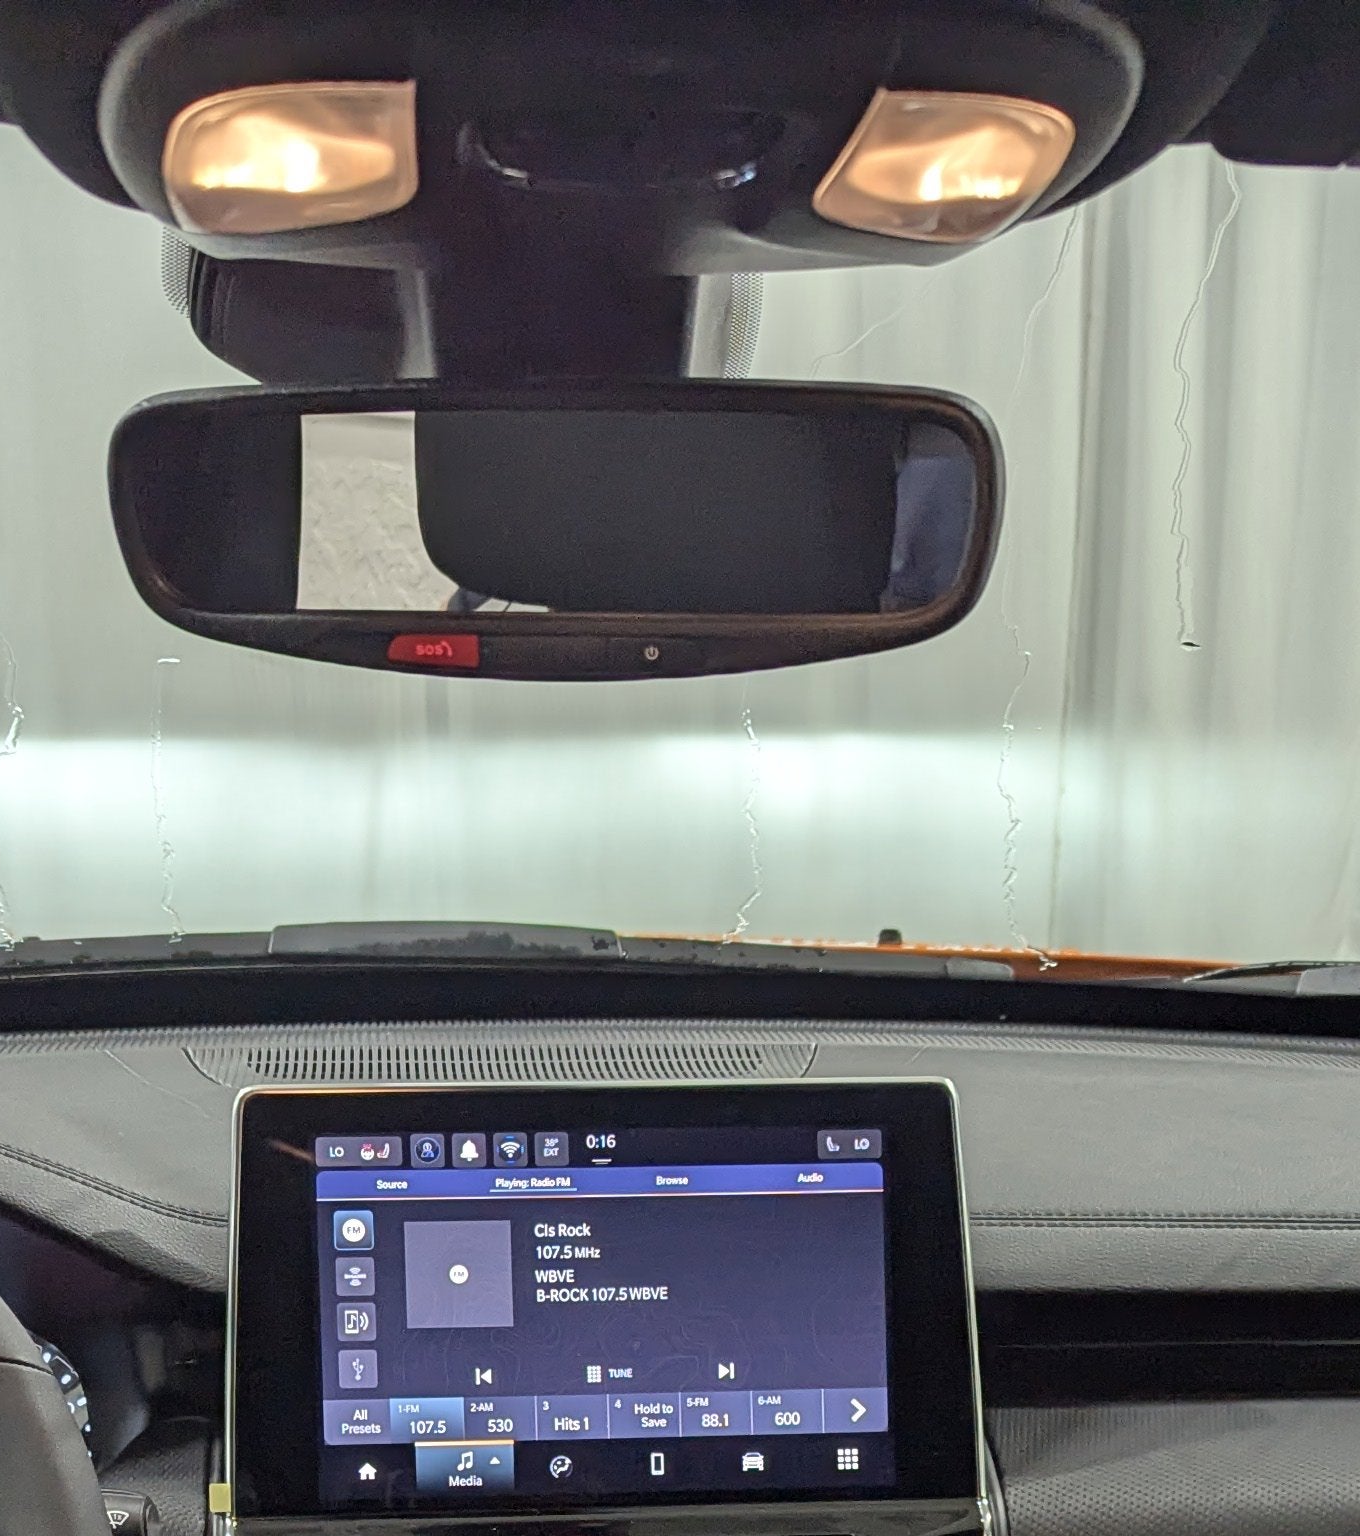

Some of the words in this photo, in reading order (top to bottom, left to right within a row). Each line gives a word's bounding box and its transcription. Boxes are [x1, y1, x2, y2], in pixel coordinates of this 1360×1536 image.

[415, 644, 444, 656] SOS
[585, 1133, 617, 1149] 0:16
[853, 1138, 870, 1151] LO
[329, 1146, 345, 1158] LO
[495, 1177, 529, 1190] Playing:
[530, 1176, 554, 1188] Radio
[555, 1176, 571, 1188] FM
[655, 1175, 689, 1186] Browse
[797, 1172, 824, 1183] Audio
[376, 1179, 408, 1190] Source
[346, 1226, 361, 1235] FM
[557, 1223, 592, 1238] Rock
[535, 1245, 573, 1260] 107.5
[574, 1247, 601, 1260] MHz
[534, 1269, 575, 1284] WBVE
[535, 1287, 590, 1303] B-ROCK
[591, 1287, 628, 1301] 107.5
[629, 1286, 668, 1301] WBVE
[608, 1368, 633, 1379] TUNE
[542, 1401, 549, 1411] 3
[614, 1399, 622, 1409] 4
[686, 1397, 709, 1408] 5-FM
[757, 1395, 782, 1405] 6-AM
[397, 1404, 420, 1414] 1-FM
[470, 1402, 494, 1413] 2-AM
[634, 1403, 660, 1415] Hold
[661, 1403, 674, 1414] to
[353, 1409, 368, 1421] All
[701, 1413, 730, 1428] 88.1
[774, 1412, 801, 1426] 600
[409, 1420, 447, 1434] 107.5
[487, 1418, 513, 1433] 530
[554, 1416, 580, 1431] Hits
[582, 1416, 590, 1430] 1
[641, 1417, 667, 1428] Save
[341, 1423, 381, 1435] Presets
[448, 1475, 483, 1487] Media
